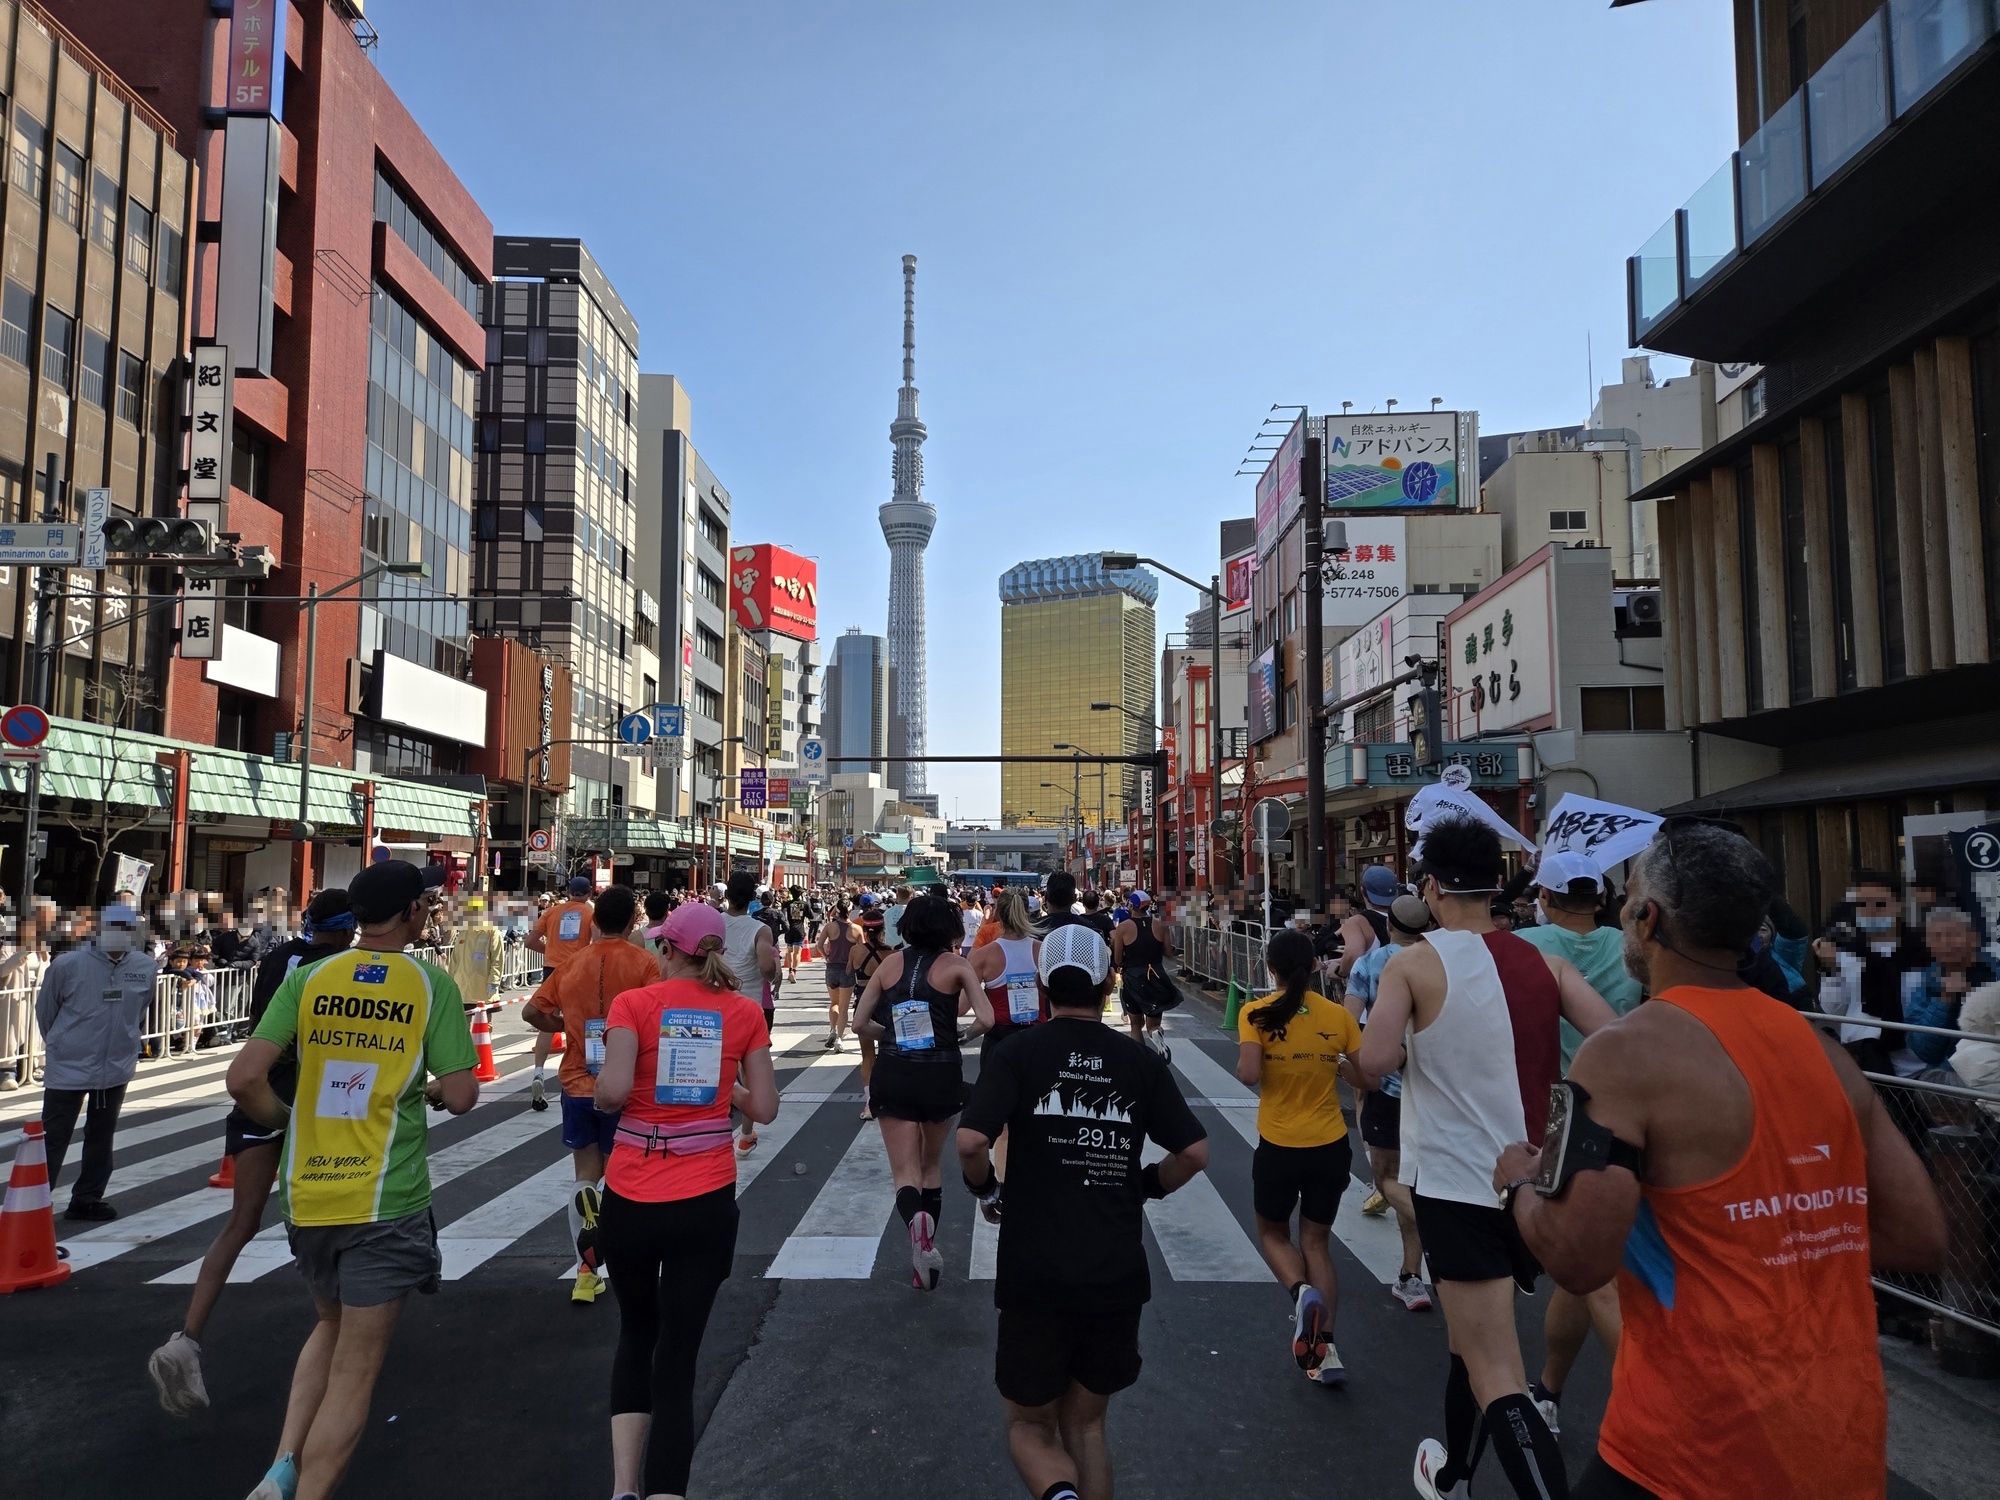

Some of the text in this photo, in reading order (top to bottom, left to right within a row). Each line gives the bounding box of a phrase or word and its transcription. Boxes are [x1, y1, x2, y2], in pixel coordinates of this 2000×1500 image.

[236, 86, 263, 103] 5F
[194, 365, 221, 480] 紀文堂
[1351, 423, 1431, 436] 自然エネルギー
[1357, 437, 1452, 455] アドバンス
[86, 491, 104, 566] スクランブル式
[49, 548, 69, 559] Gate
[733, 547, 763, 626] つぼ八
[774, 576, 817, 606] つぼ八
[1436, 799, 1472, 816] ABEREN
[313, 995, 414, 1025] GRODSKI
[308, 1029, 405, 1053] AUSTRALIA
[1059, 1071, 1112, 1084] 100mile Finisher
[306, 1156, 371, 1168] NEW YORK
[298, 1170, 371, 1182] MARATHON 2019
[1088, 1169, 1100, 1177] May
